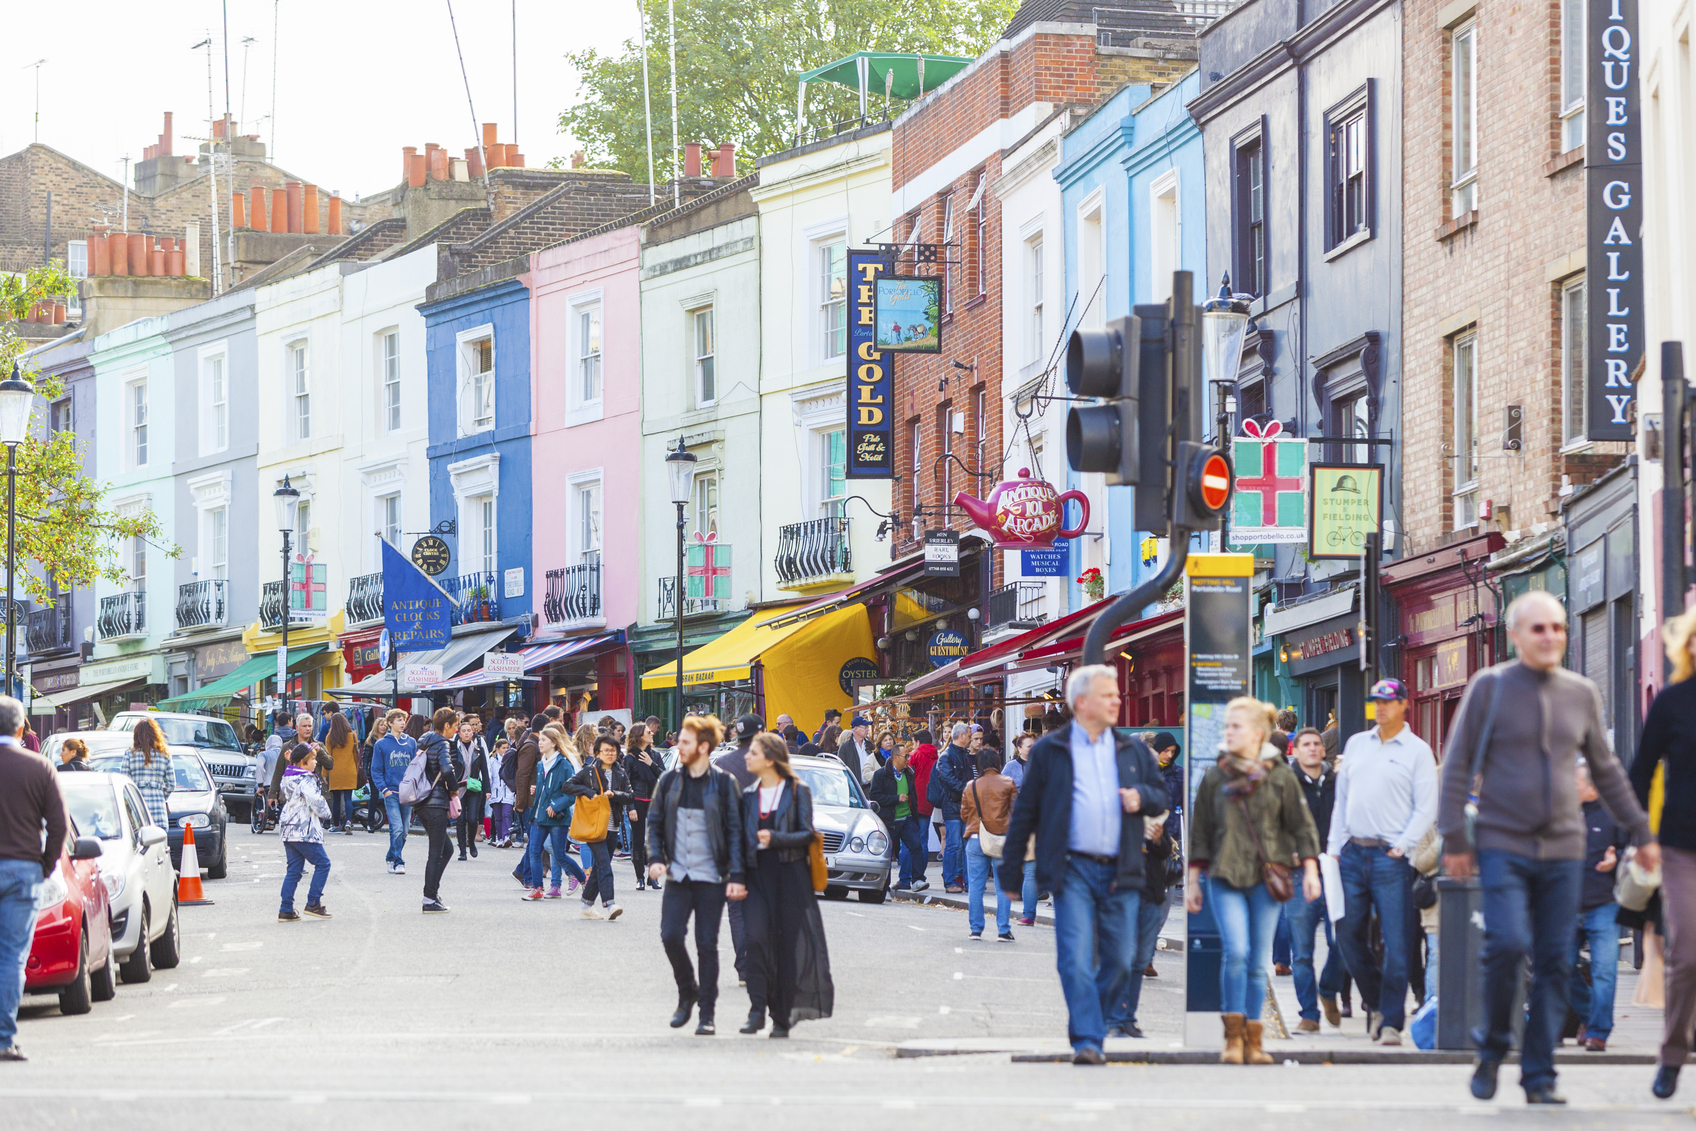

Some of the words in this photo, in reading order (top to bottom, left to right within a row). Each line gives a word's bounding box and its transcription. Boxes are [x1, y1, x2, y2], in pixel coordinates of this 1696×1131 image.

[896, 280, 908, 290] The
[890, 291, 912, 306] Gold
[1602, 180, 1633, 425] GALLERY
[857, 341, 884, 425] GOLD
[862, 433, 881, 443] Pub
[856, 442, 877, 454] Grill
[876, 442, 886, 452] &
[858, 452, 884, 462] Hotel
[996, 484, 1058, 515] ANTIQUE
[1323, 498, 1369, 506] STUMPER
[1025, 501, 1046, 517] 101
[1323, 513, 1369, 521] FIELDING
[1001, 510, 1059, 538] ARCADE
[1232, 531, 1305, 542] shopportobello.co.uk
[391, 598, 443, 611] ANTIQUE
[395, 610, 440, 622] CLOCKS
[413, 621, 423, 629] &
[393, 629, 444, 641] REPAIRS
[936, 633, 963, 649] Gallery
[930, 645, 969, 656] GUESTHOUSE
[696, 671, 714, 682] BAZAAR
[842, 669, 878, 679] OYSTER
